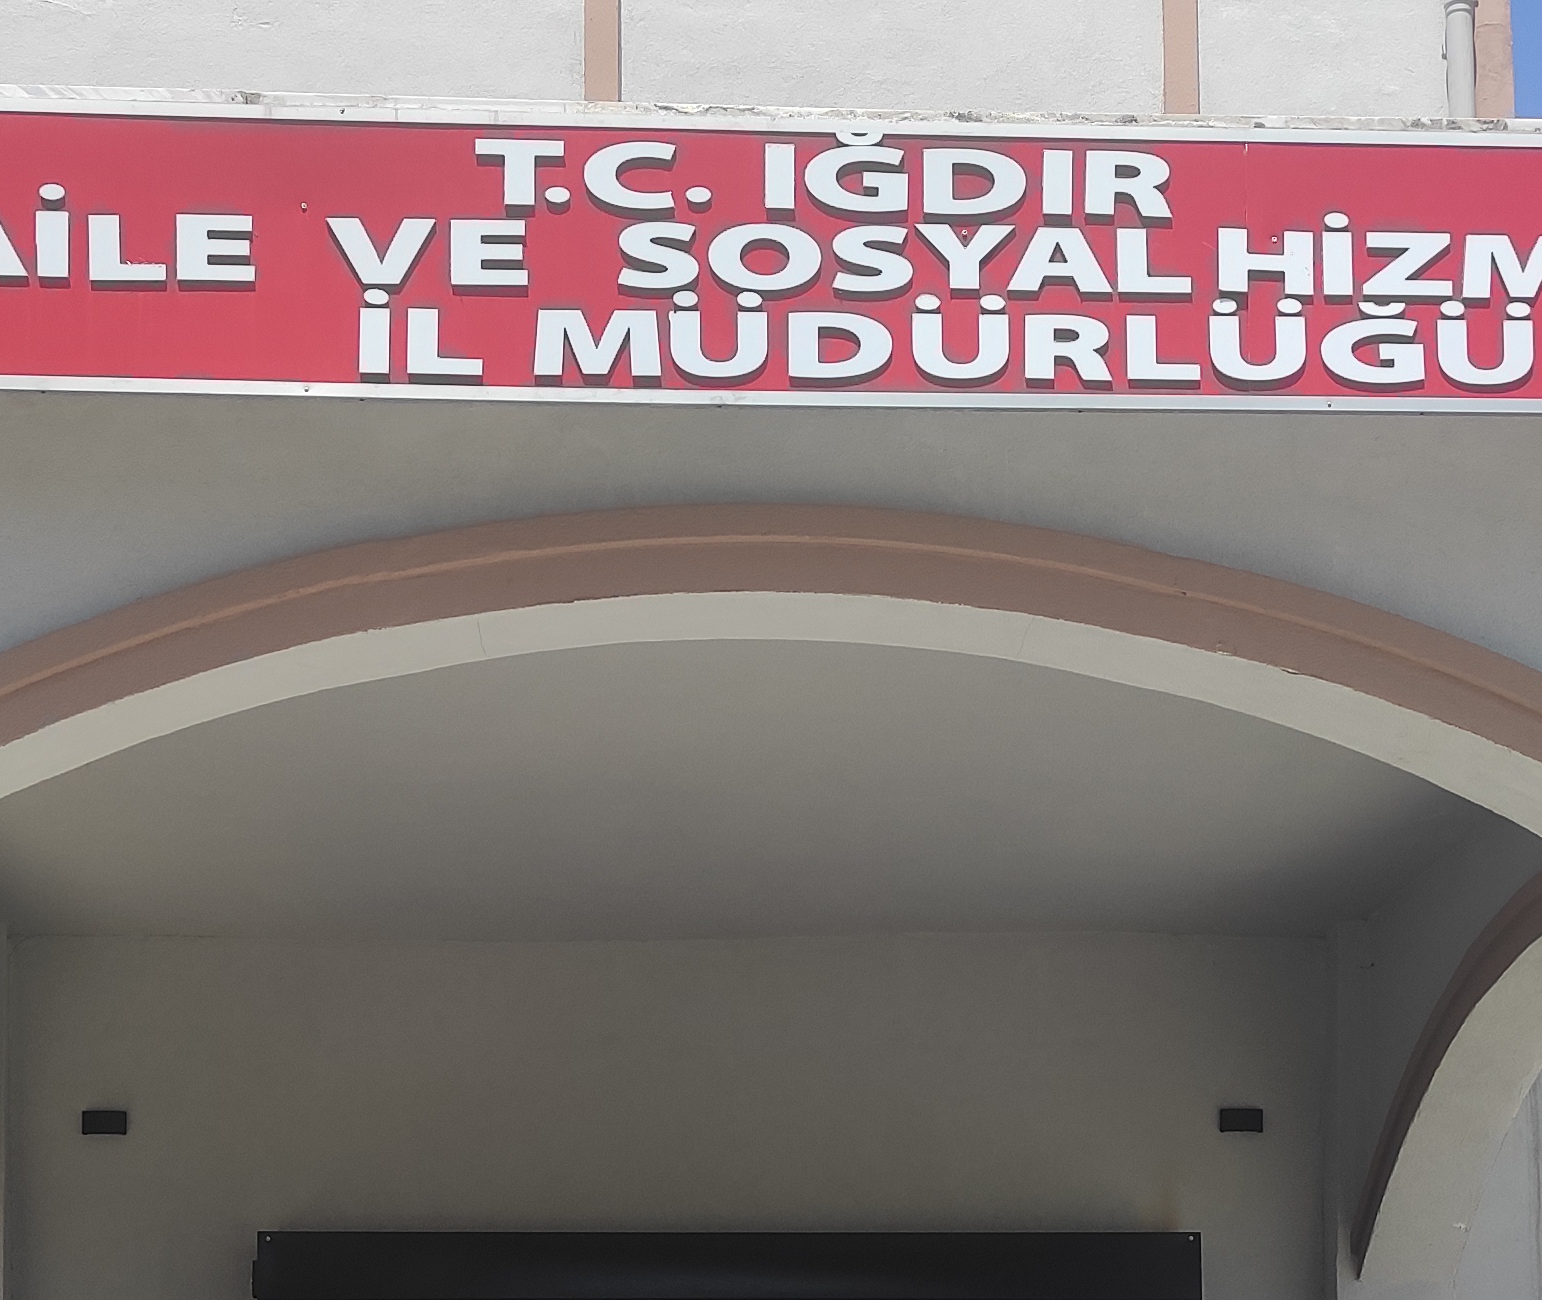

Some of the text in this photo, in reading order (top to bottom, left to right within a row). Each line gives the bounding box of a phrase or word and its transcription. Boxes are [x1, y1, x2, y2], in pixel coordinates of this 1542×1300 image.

[475, 131, 1173, 218] T.C. IĞDIR
[326, 217, 529, 286] VE
[617, 221, 1192, 294] SOSYAL
[358, 288, 1534, 385] İL MÜDÜRLÜĞÜ
